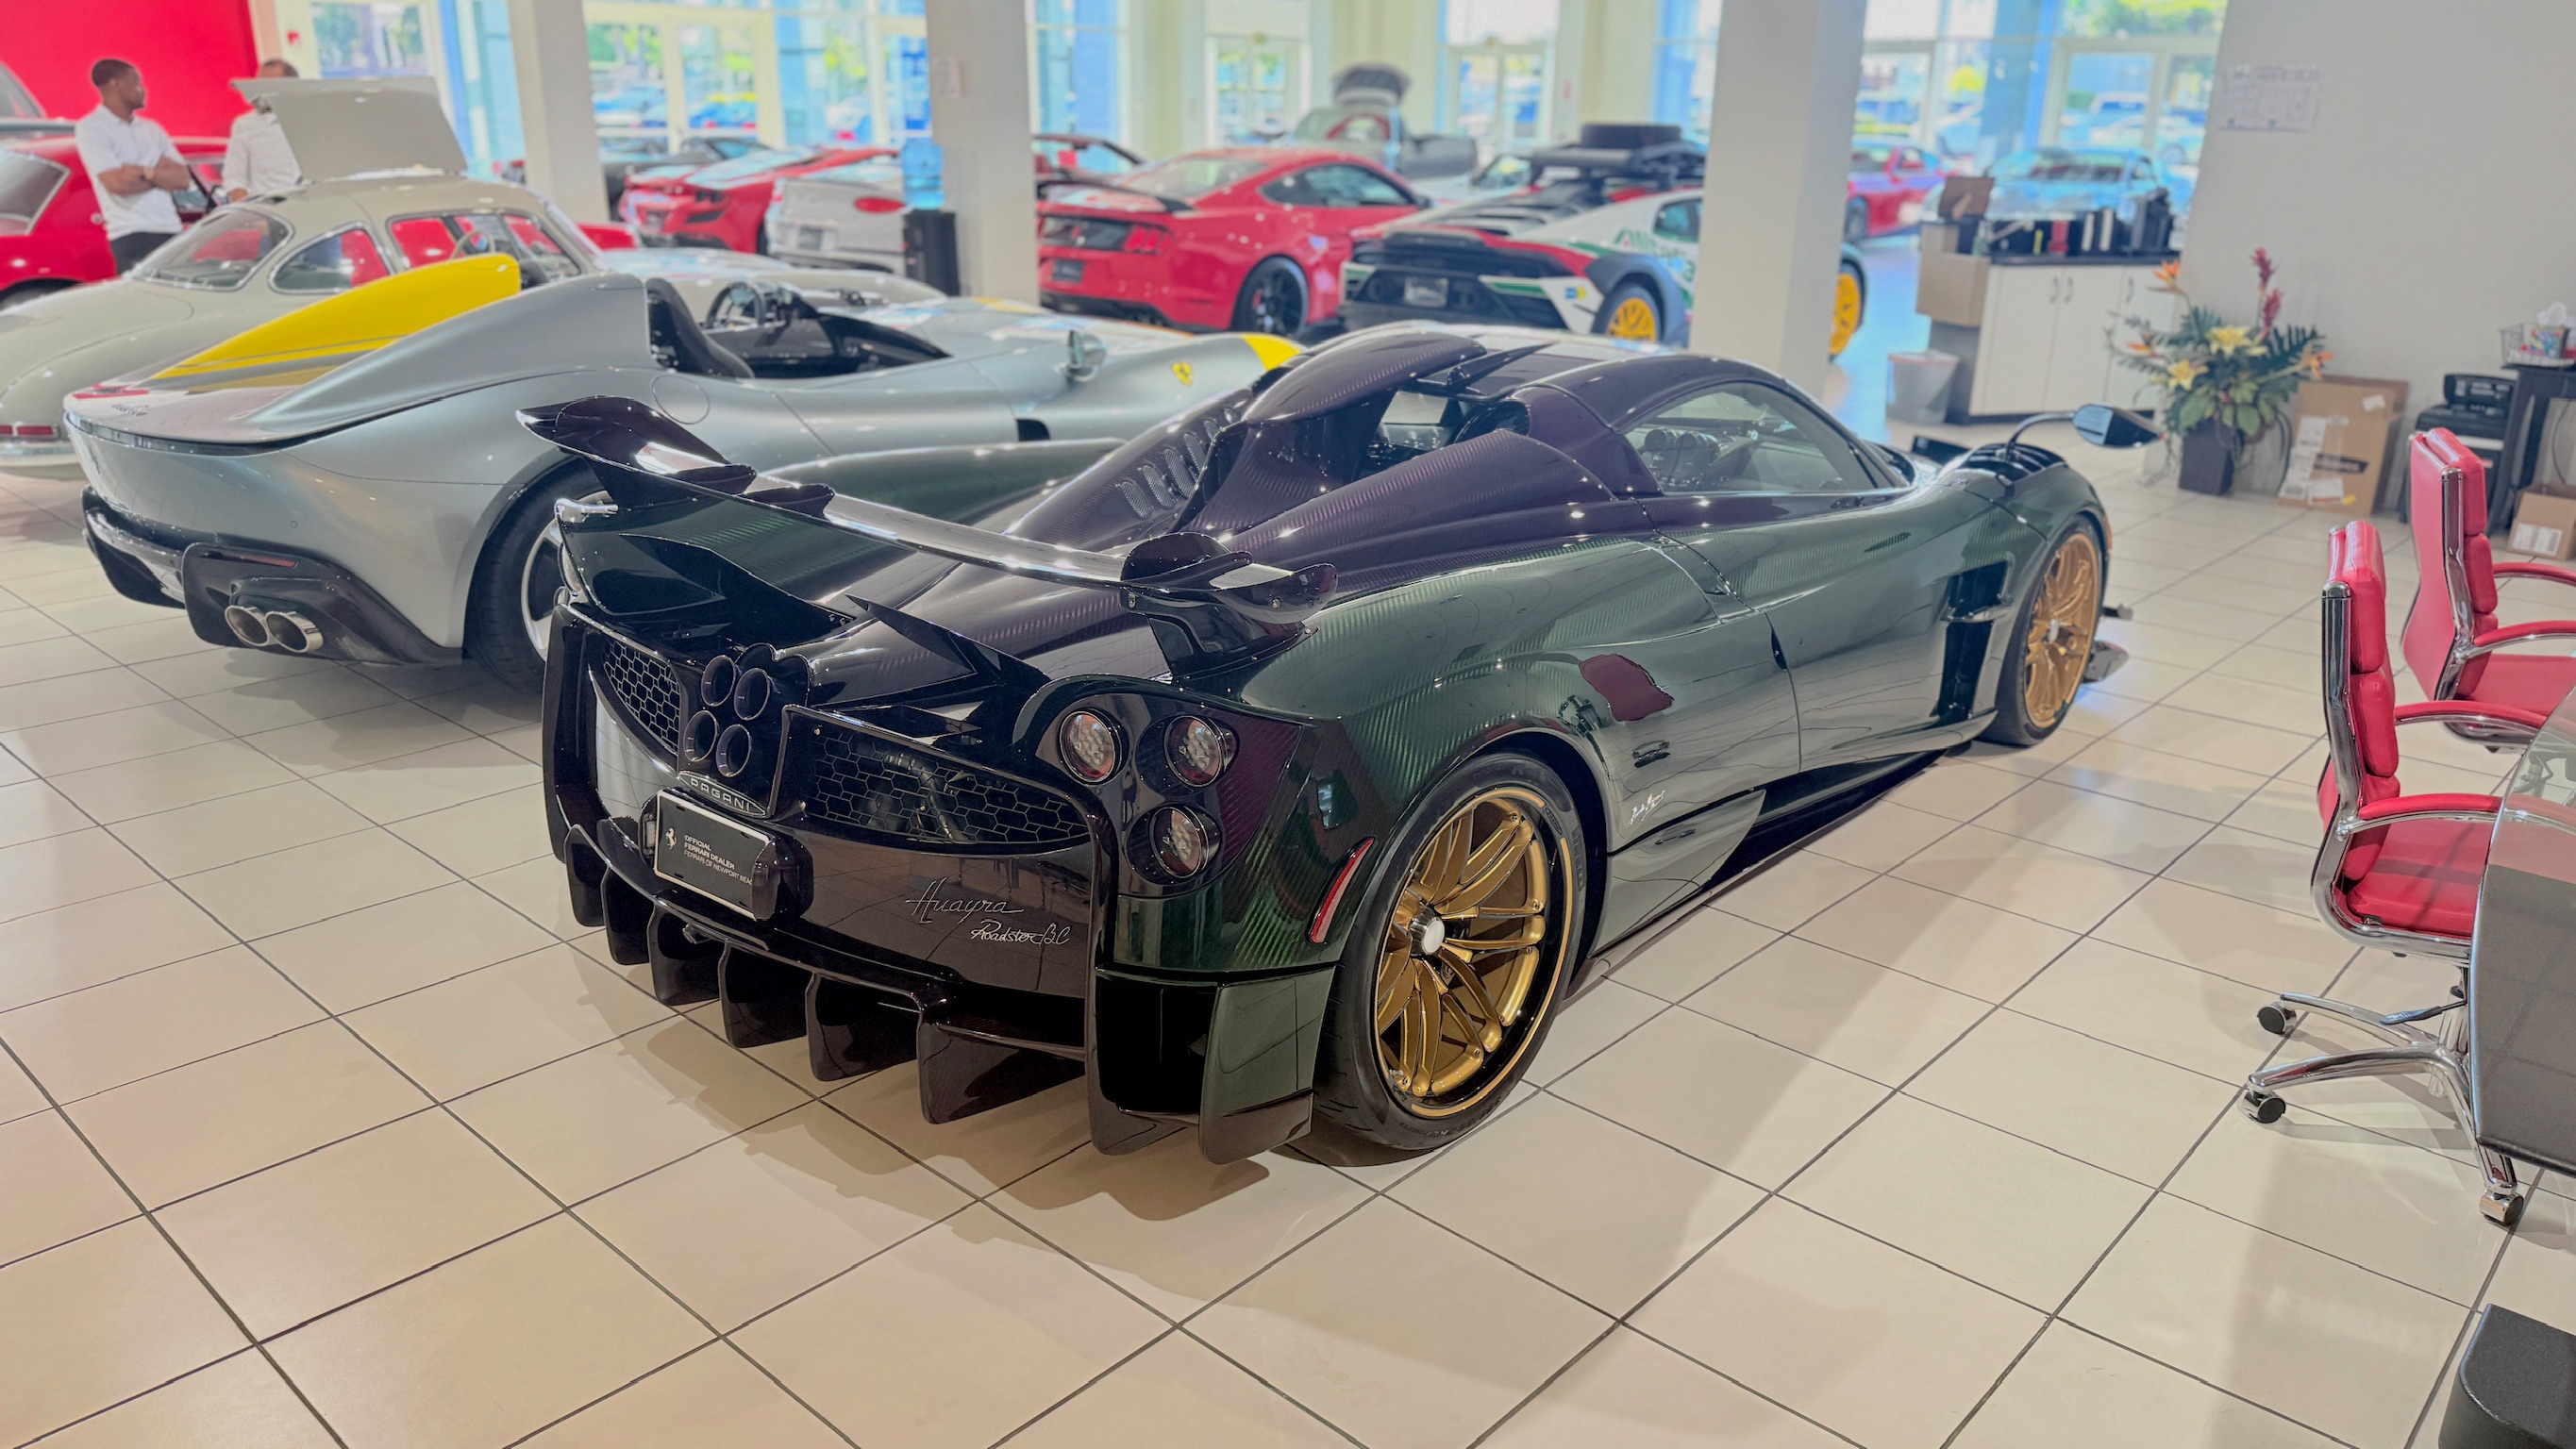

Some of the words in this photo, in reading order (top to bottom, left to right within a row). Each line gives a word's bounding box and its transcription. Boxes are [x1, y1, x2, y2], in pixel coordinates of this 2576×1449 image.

[691, 778, 750, 811] PAGANI
[684, 835, 711, 851] OFFICIAL
[685, 842, 711, 858] FERRARI
[711, 854, 735, 870] DEALER
[684, 850, 705, 865] FERRARI
[705, 858, 713, 869] OF
[713, 863, 740, 880] NEWPORT
[740, 874, 753, 885] BEAC
[905, 877, 1024, 924] Huayra
[970, 919, 1041, 943] Roadster
[1039, 923, 1071, 946] BC
